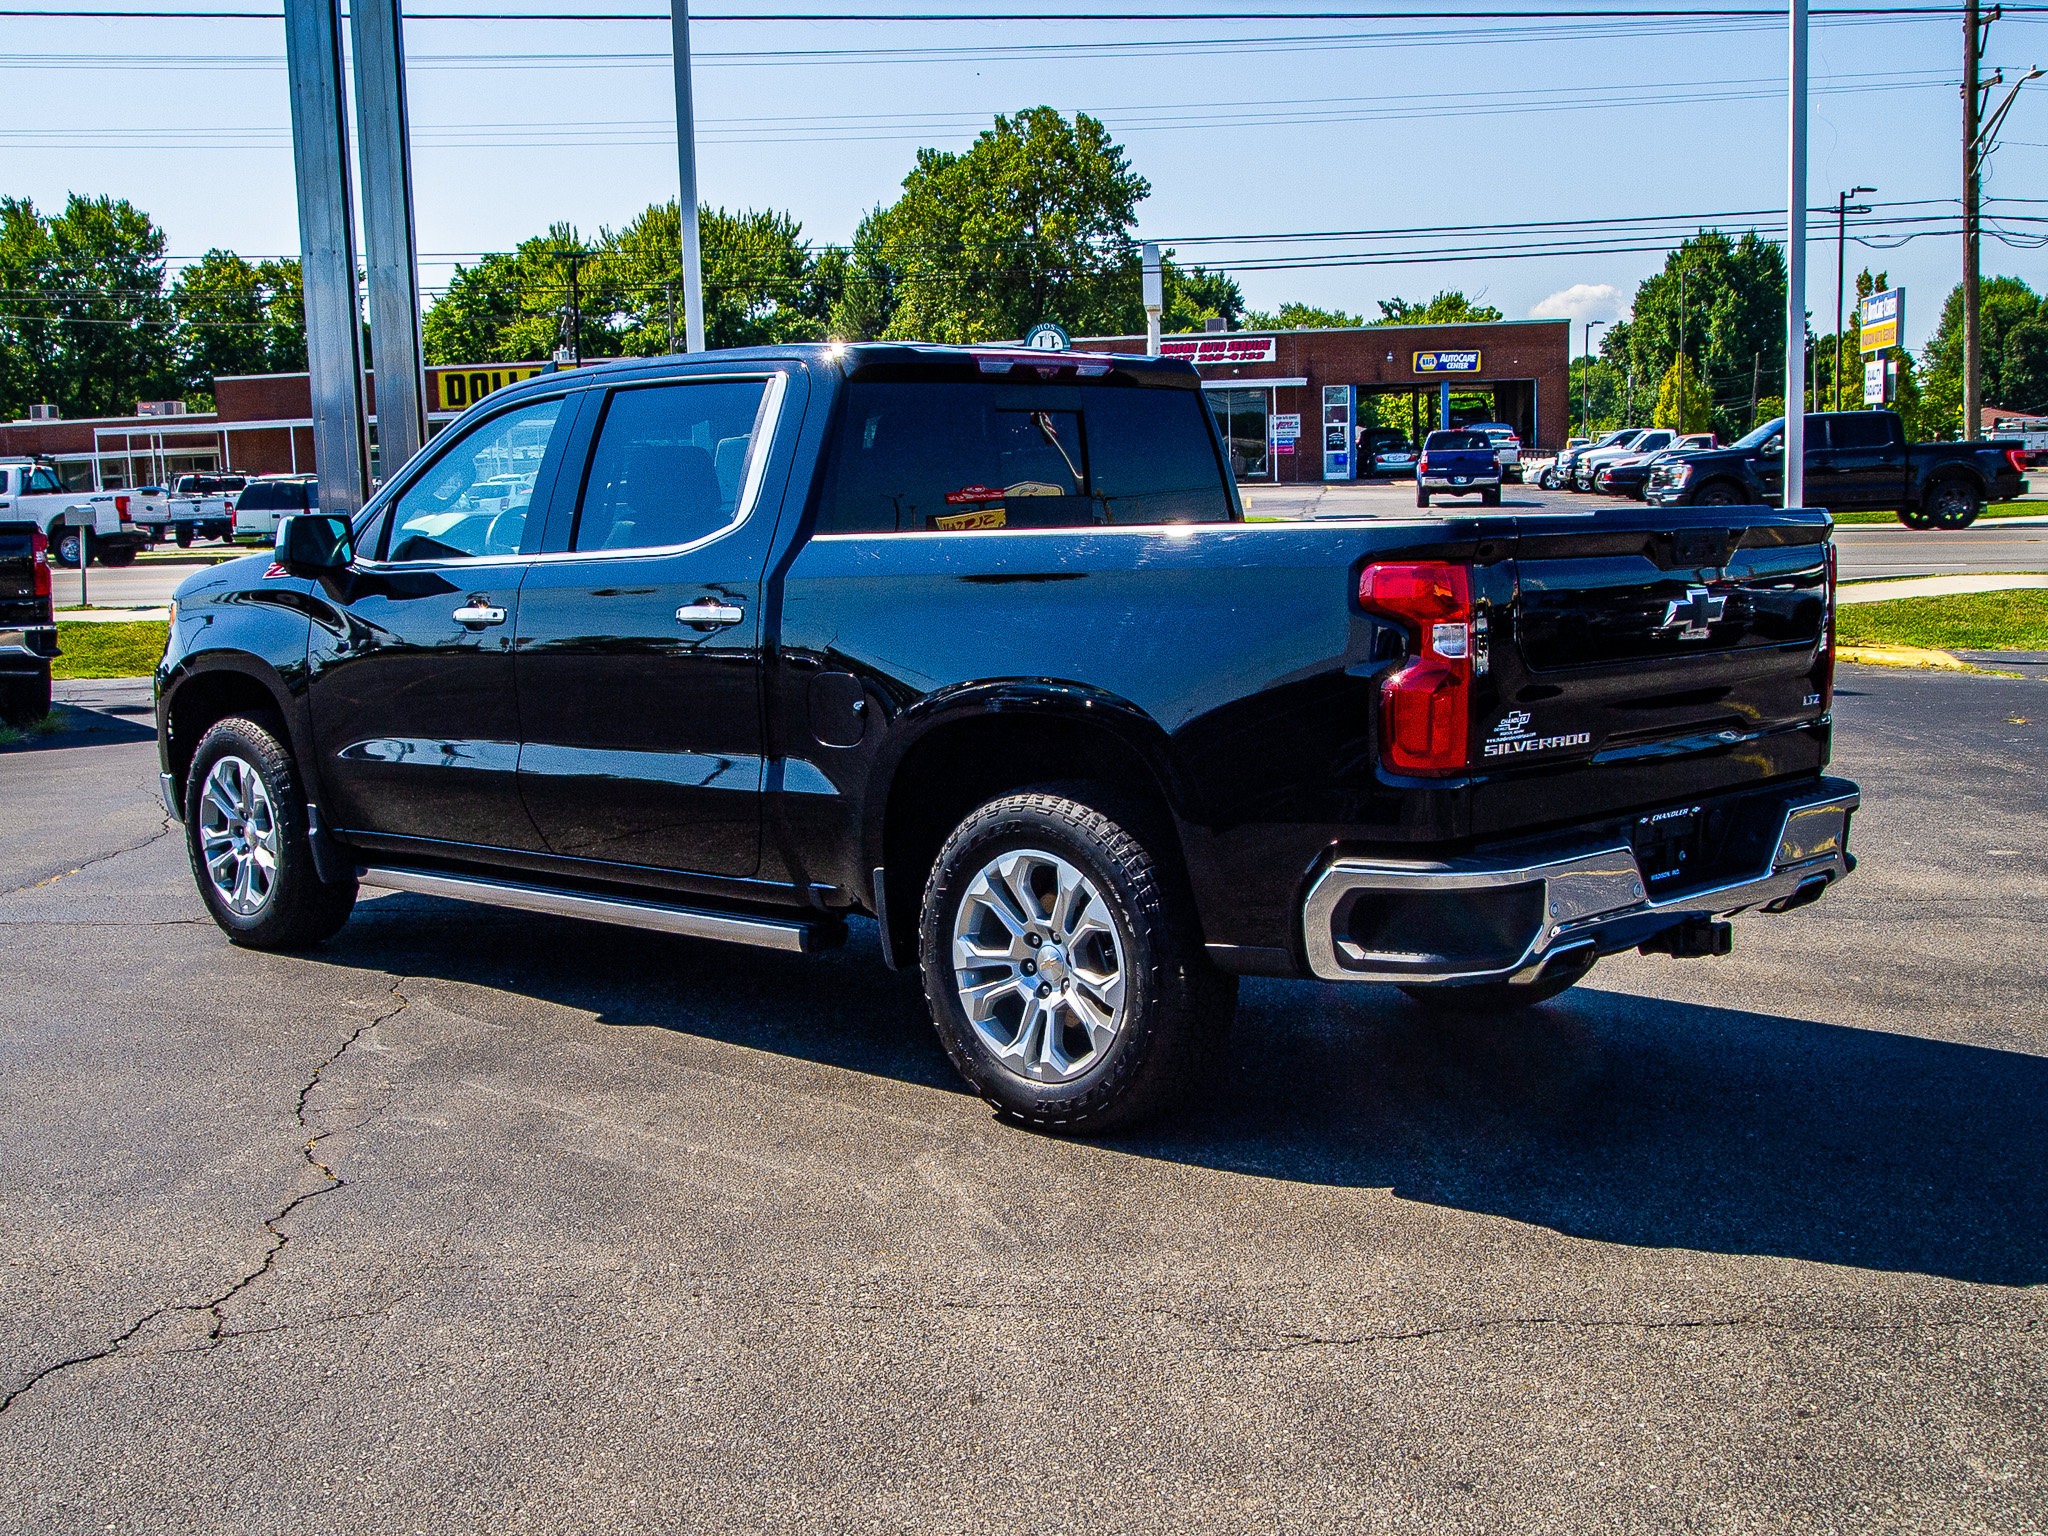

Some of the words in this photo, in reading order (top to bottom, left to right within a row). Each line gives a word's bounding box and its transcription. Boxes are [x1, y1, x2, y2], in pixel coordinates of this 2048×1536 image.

[1160, 343, 1198, 354] ADISON
[1199, 341, 1226, 353] AUTO
[1227, 340, 1271, 351] SERVICE
[1803, 694, 1820, 705] LTZ
[1484, 732, 1590, 757] SILVERADO
[1652, 808, 1689, 822] CHANDLER
